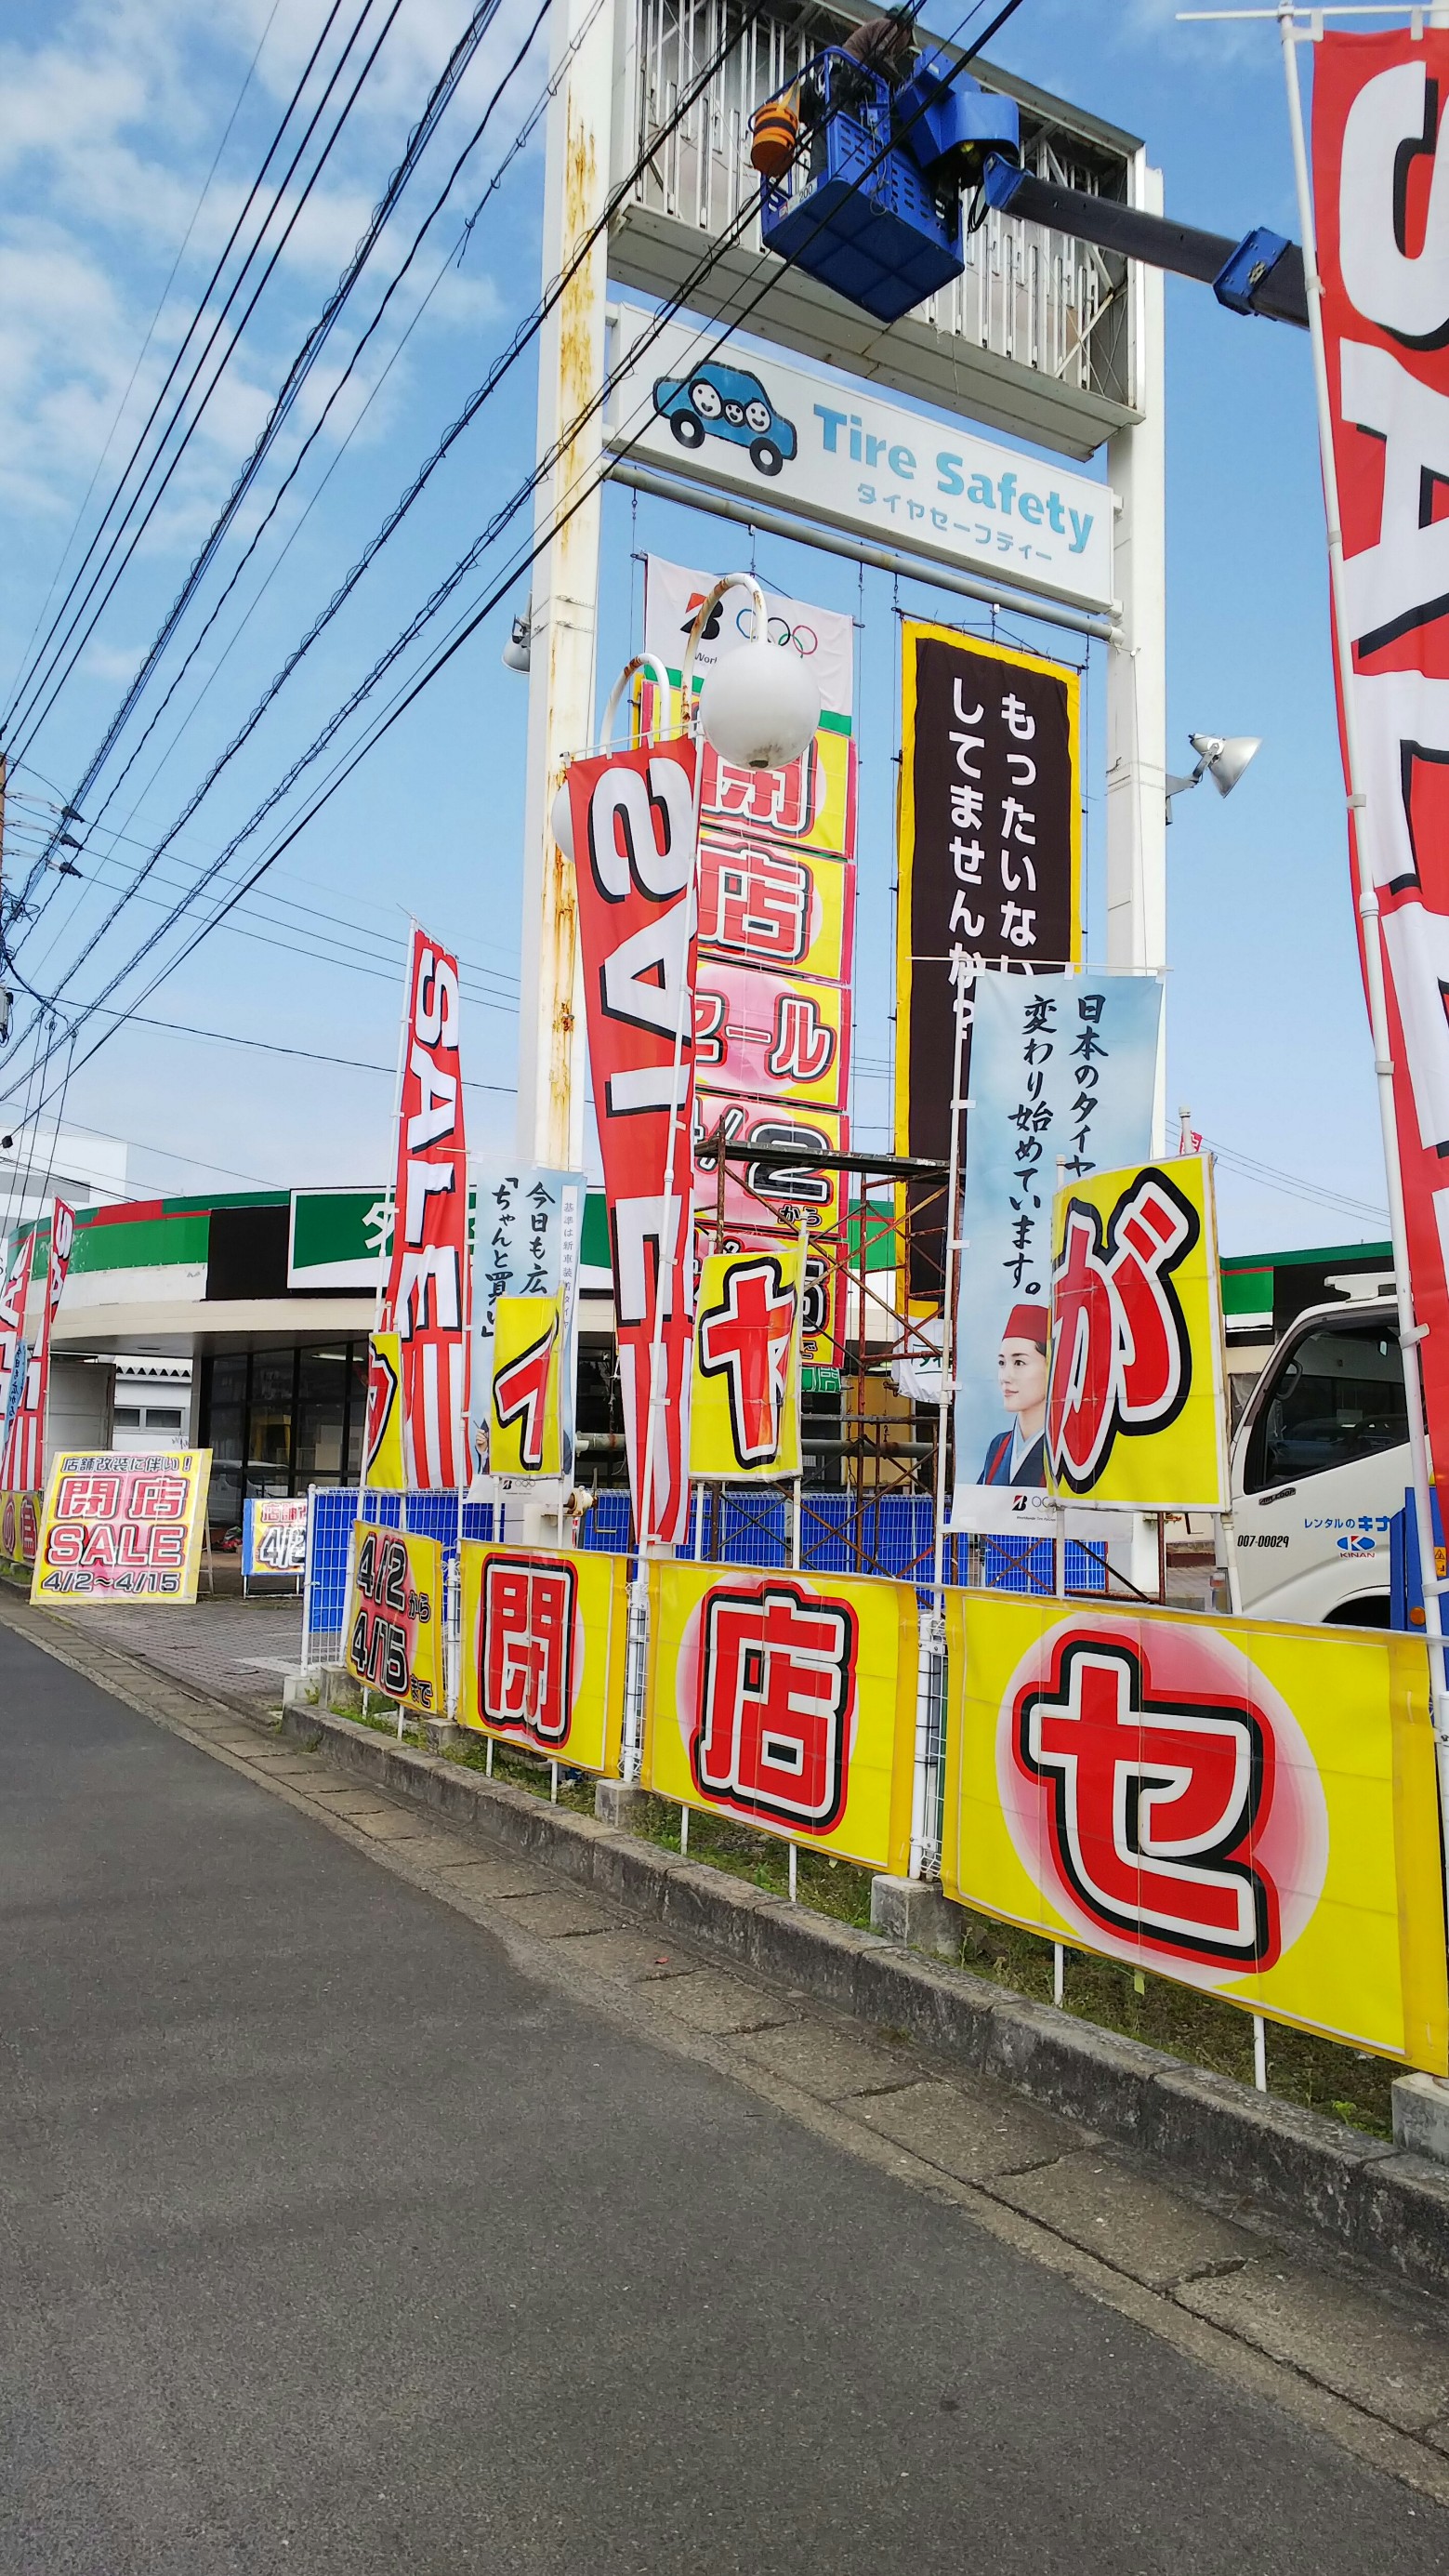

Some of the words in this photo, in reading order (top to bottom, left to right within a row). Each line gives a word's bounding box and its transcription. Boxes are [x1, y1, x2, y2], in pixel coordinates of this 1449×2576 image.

[812, 403, 916, 480] Tire
[936, 450, 1095, 555] Safety
[857, 482, 1052, 561] タイヤセーフティー
[397, 946, 463, 1343] SALE
[1008, 994, 1058, 1297] 変わり始めています。
[1063, 994, 1110, 1178] 日本のタイヤ
[519, 1181, 556, 1295] 今日も広
[493, 1306, 560, 1473] イ
[1047, 1167, 1201, 1493] が
[56, 1475, 191, 1521] 閉店
[61, 1456, 192, 1473] 店舗改装に伴い！
[1236, 1535, 1290, 1548] 007-00029
[45, 1523, 190, 1568] SALE
[691, 1579, 860, 1837] 店
[1011, 1628, 1283, 1975] セ
